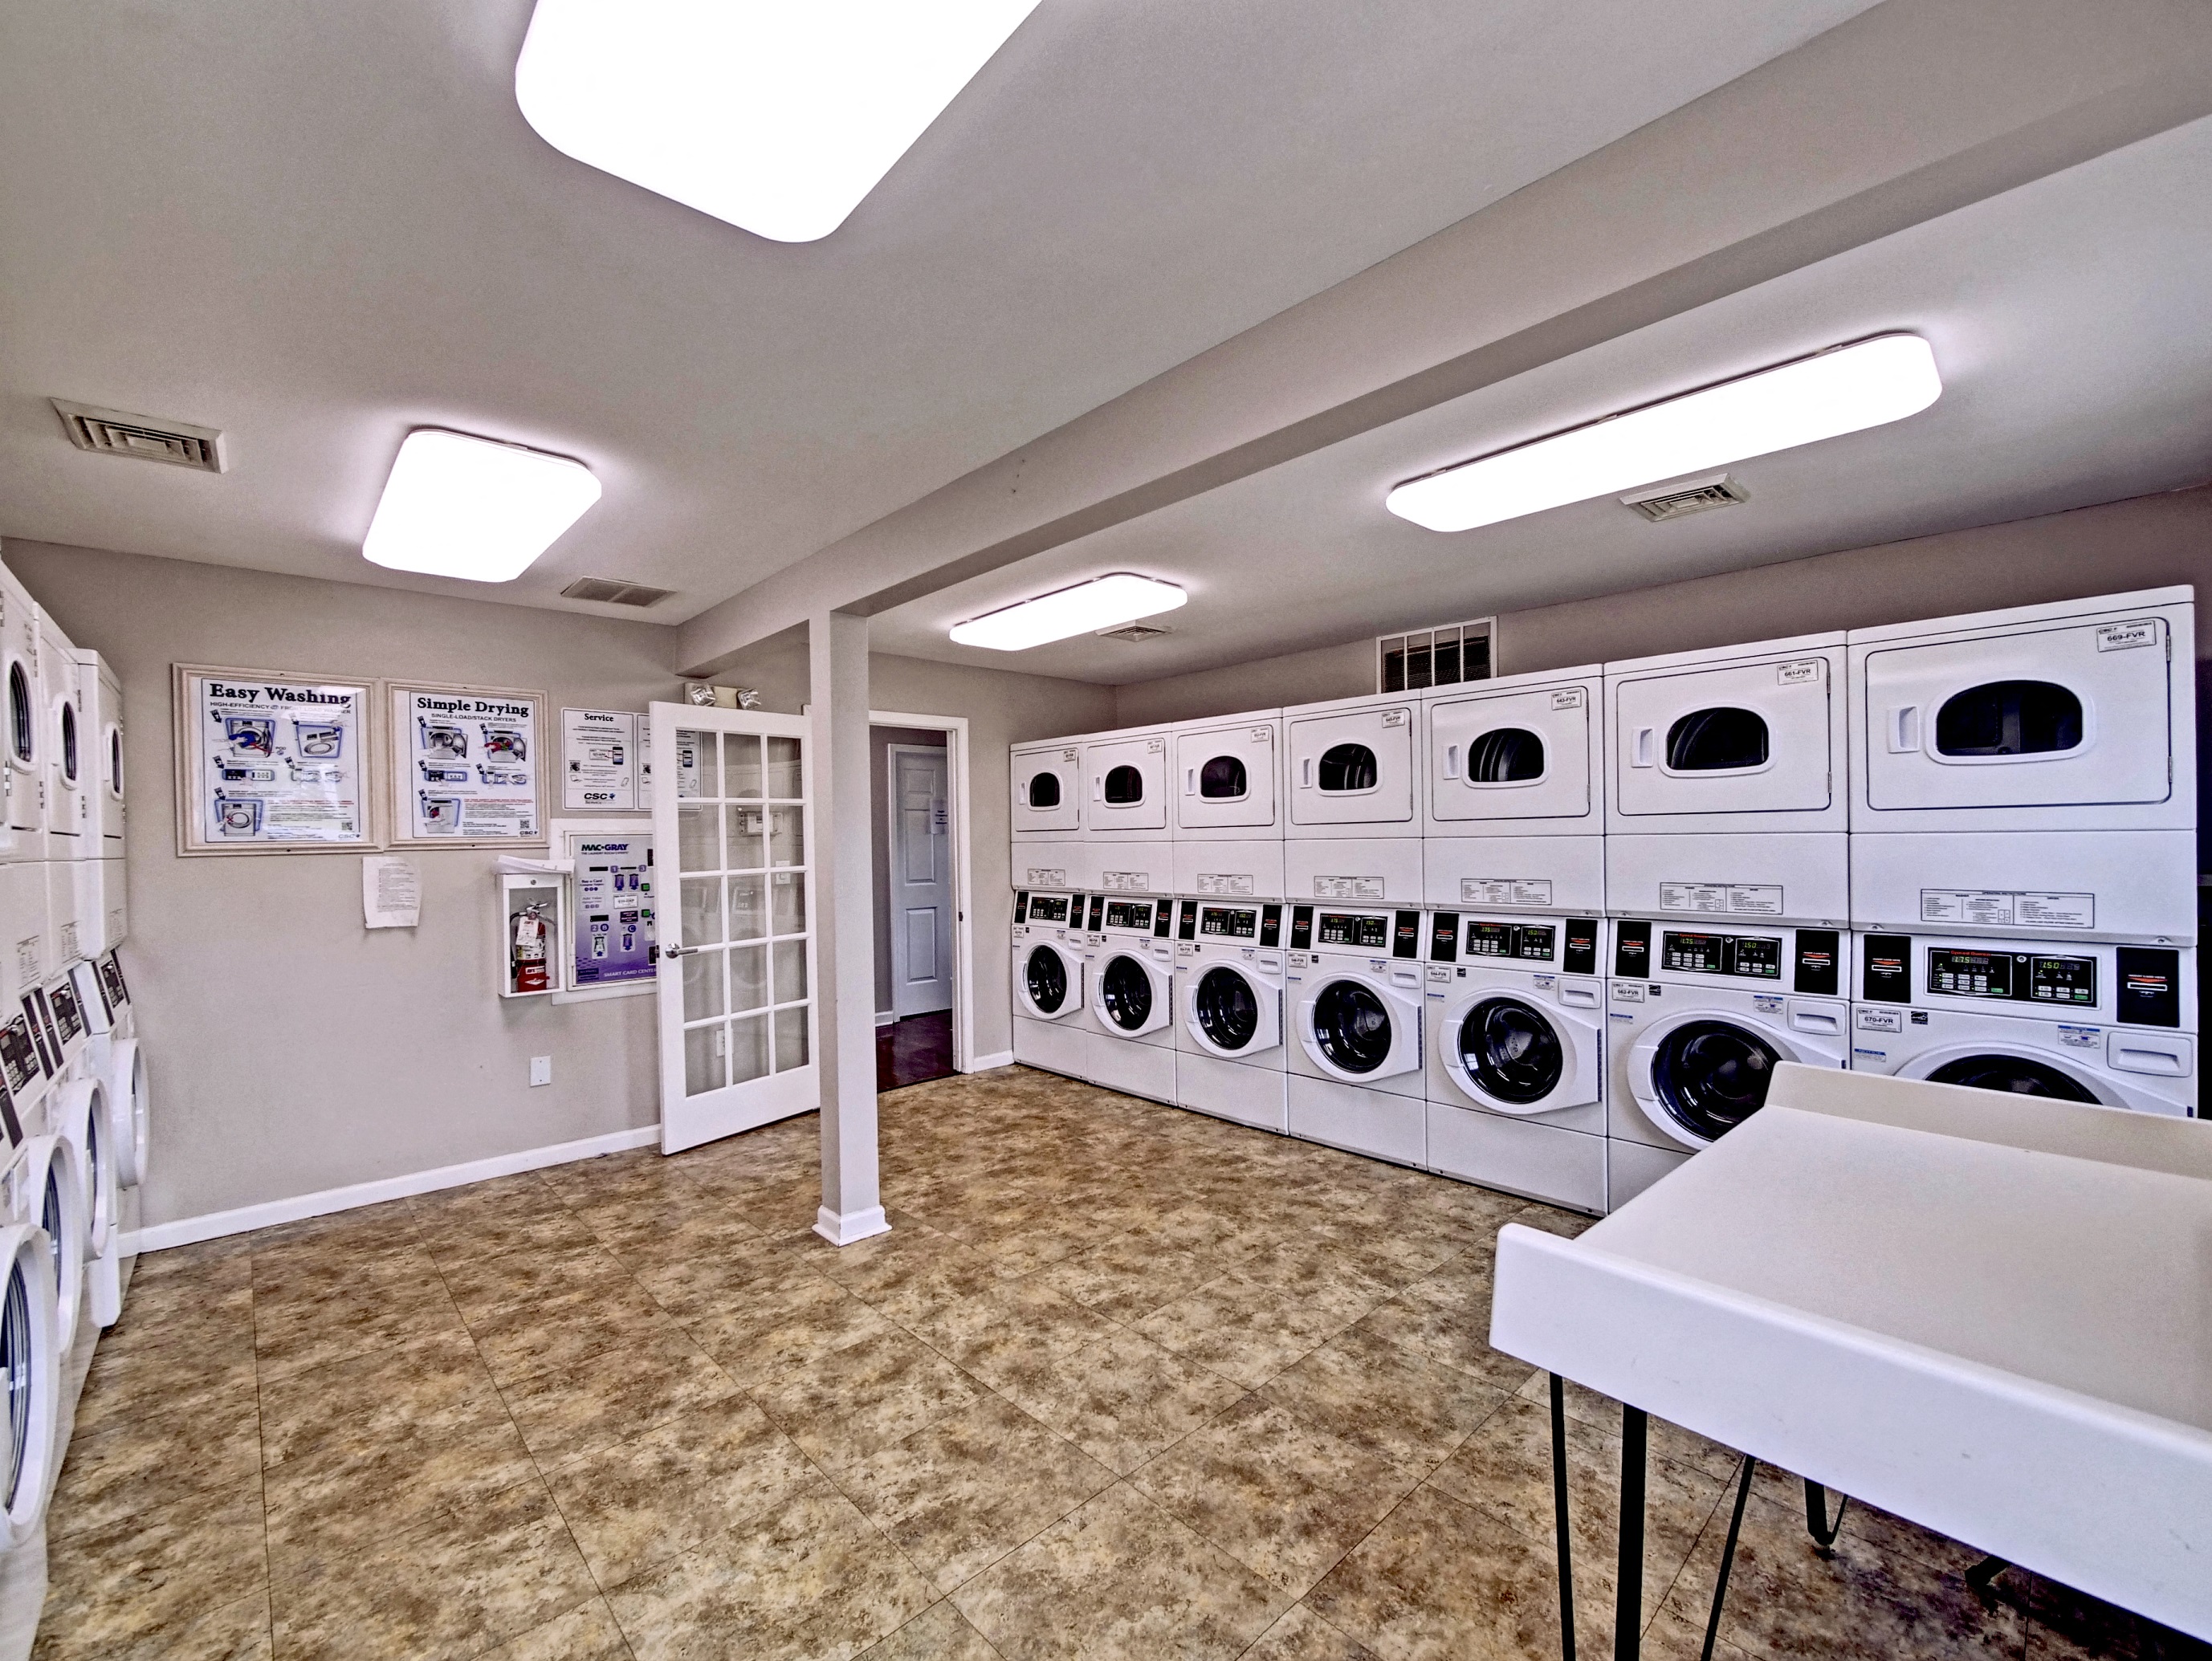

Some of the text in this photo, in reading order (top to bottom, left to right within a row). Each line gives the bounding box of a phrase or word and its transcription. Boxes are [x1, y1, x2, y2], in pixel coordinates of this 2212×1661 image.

[2107, 631, 2145, 641] 669-FVR
[210, 683, 351, 708] Easy Washing
[210, 702, 270, 710] HIGH-EFFICIENCY
[417, 697, 529, 718] Simple Drying
[585, 713, 614, 722] Service
